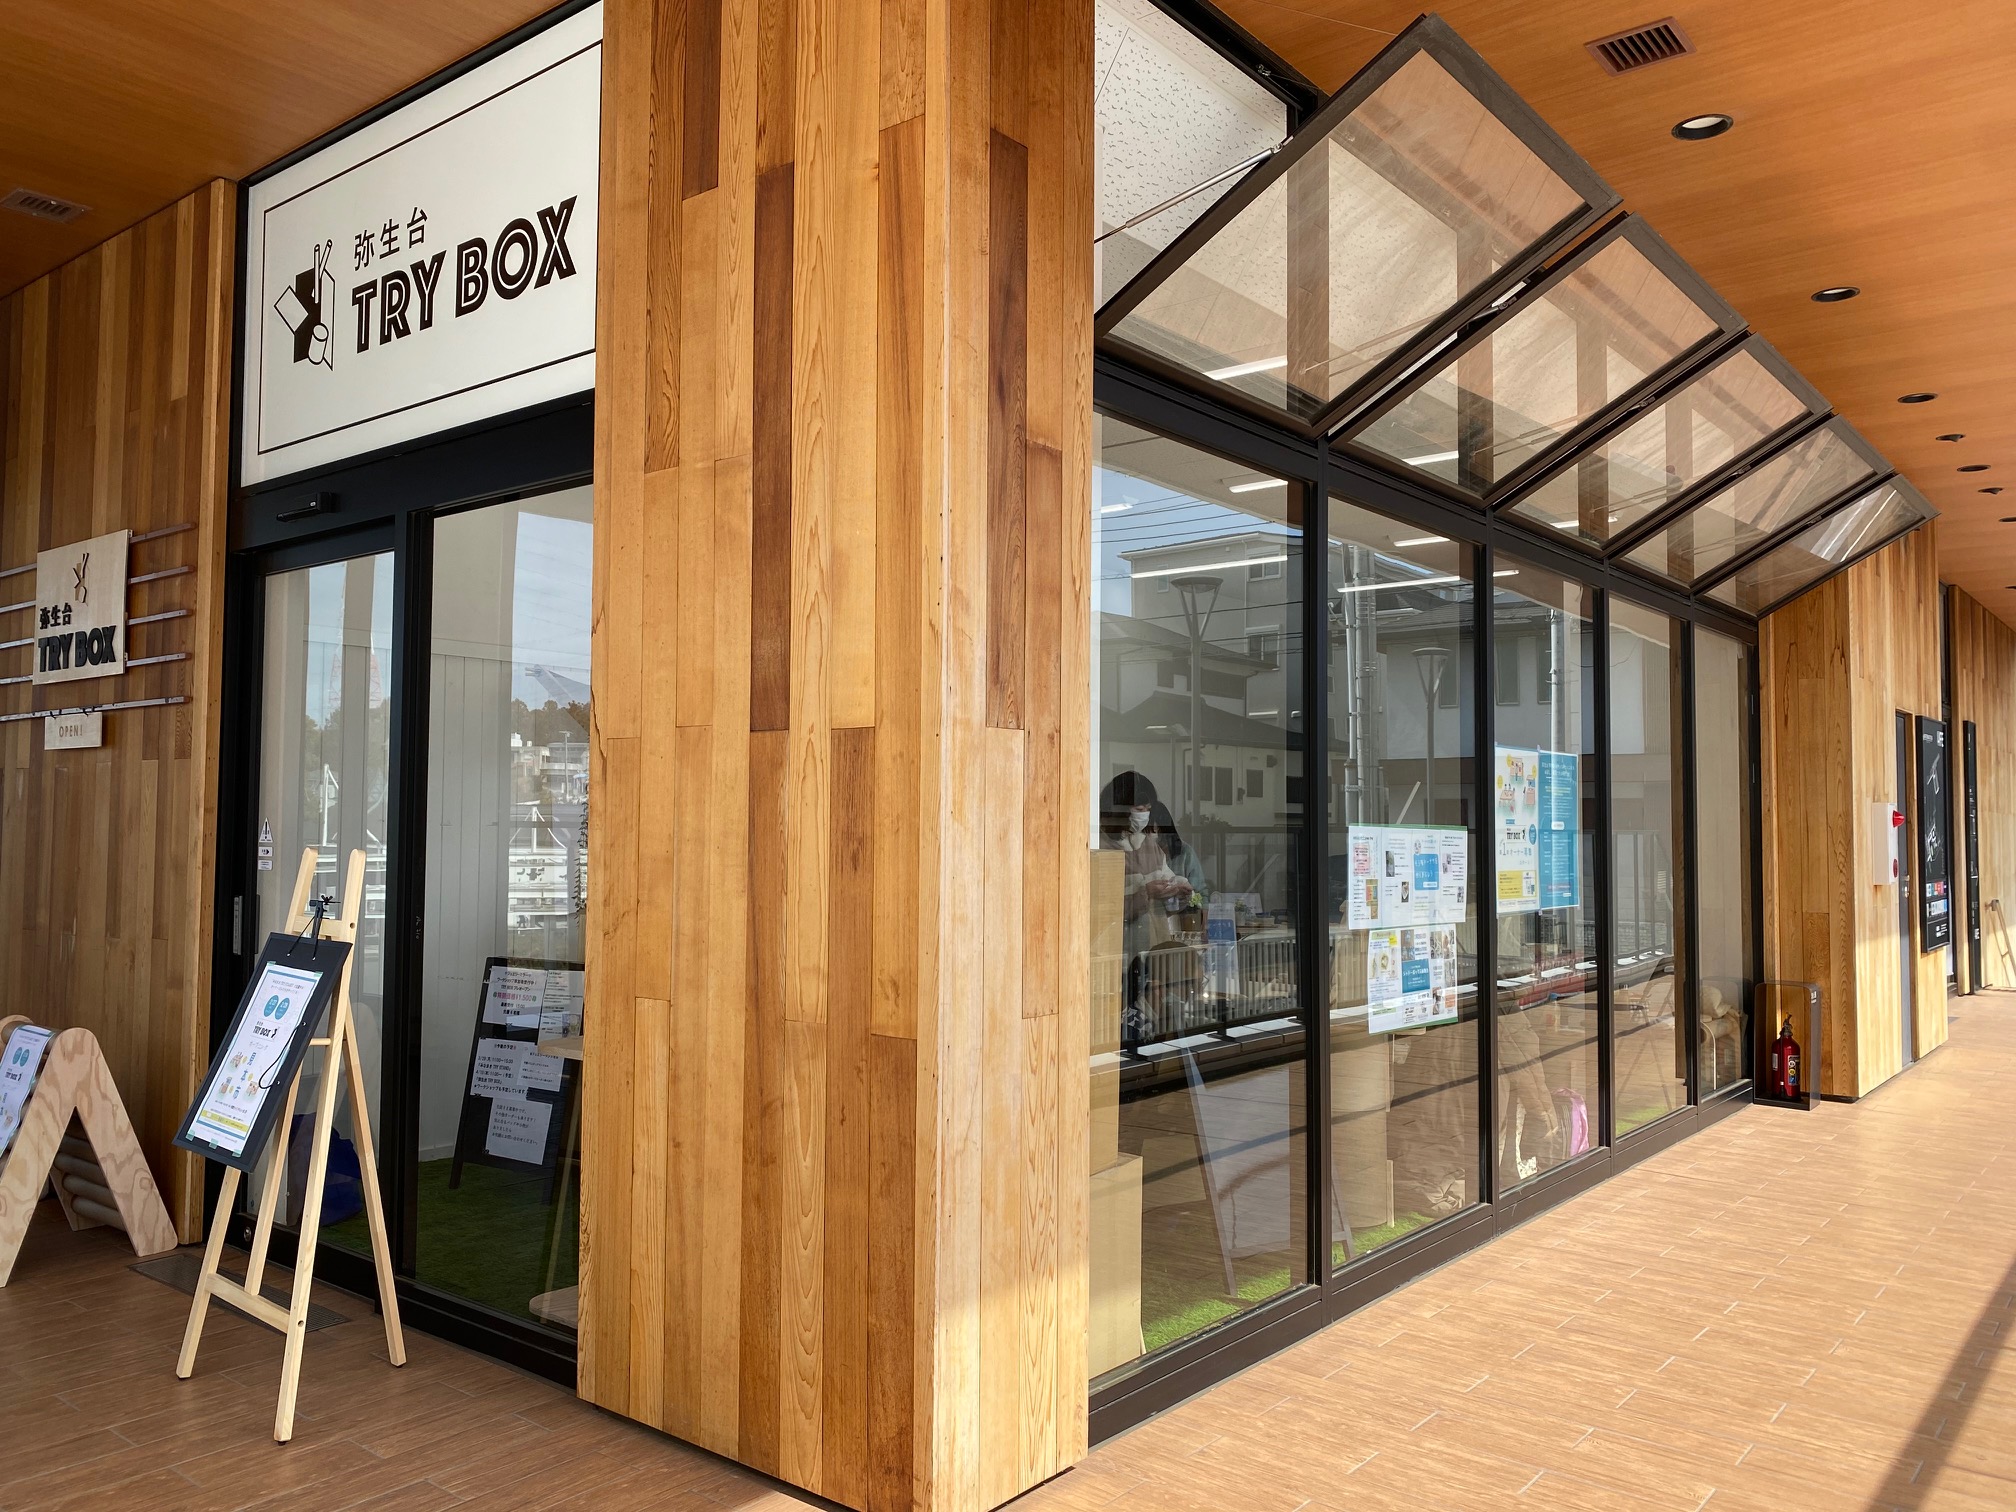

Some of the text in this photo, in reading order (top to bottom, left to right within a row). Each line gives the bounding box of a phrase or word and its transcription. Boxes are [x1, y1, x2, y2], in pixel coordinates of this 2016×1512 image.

[353, 206, 428, 271] 弥生台
[351, 195, 578, 354] TRY BOX
[39, 602, 72, 629] 弥生台
[38, 625, 116, 672] TRY BOX
